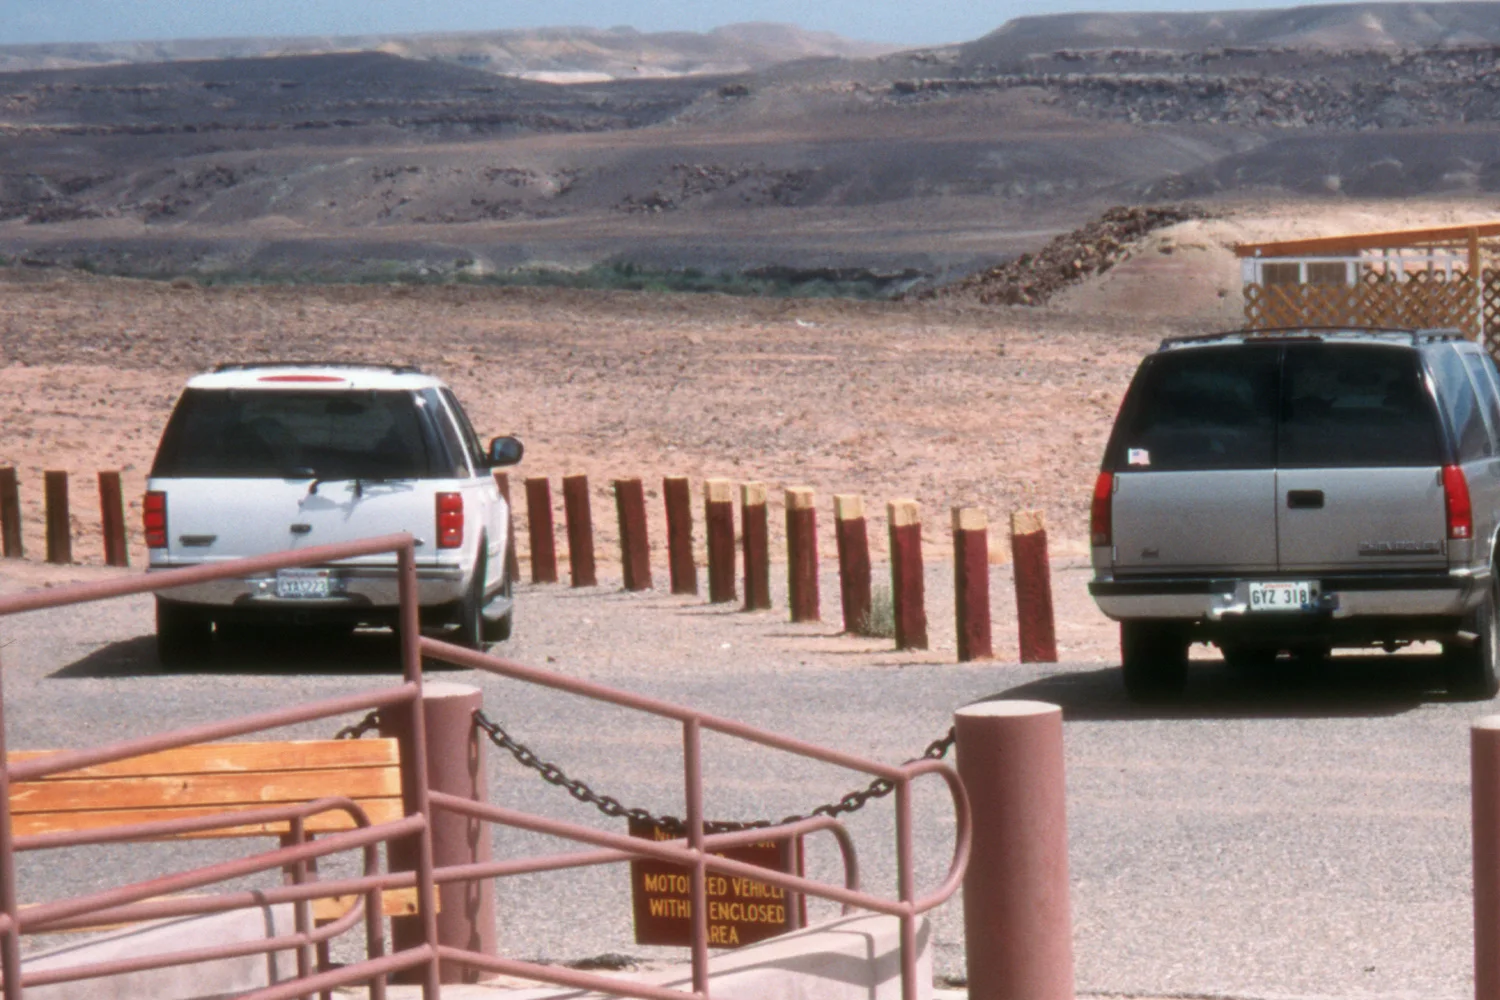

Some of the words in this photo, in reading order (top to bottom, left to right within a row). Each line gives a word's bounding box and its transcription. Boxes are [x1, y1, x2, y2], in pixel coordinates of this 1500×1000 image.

[1252, 589, 1276, 605] GYZ
[1284, 589, 1307, 604] 318
[649, 898, 692, 918] WITHI
[709, 901, 785, 924] ENCLOSED
